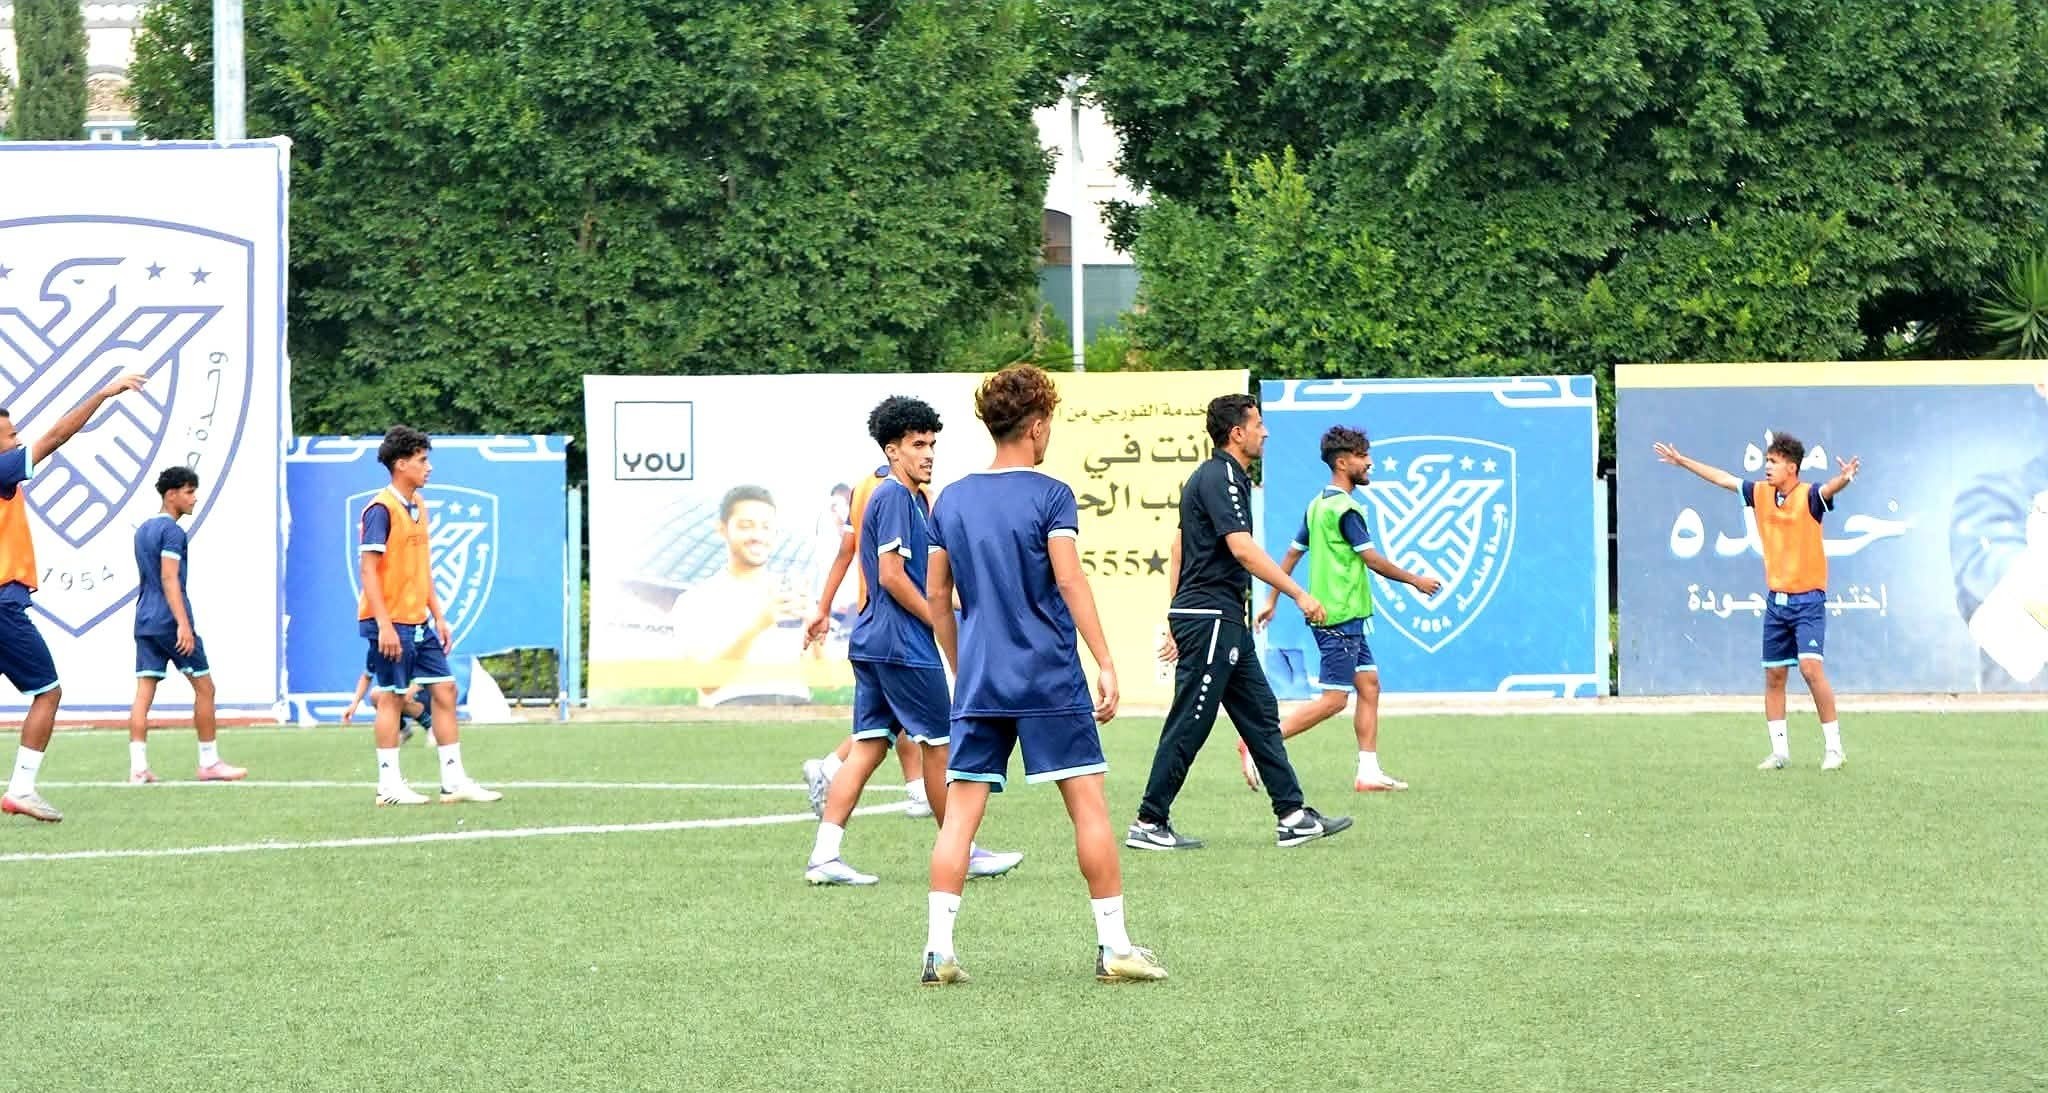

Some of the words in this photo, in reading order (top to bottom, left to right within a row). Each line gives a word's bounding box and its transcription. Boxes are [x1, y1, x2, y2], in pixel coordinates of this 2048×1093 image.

[623, 452, 686, 472] YOU
[1084, 433, 1141, 480] في
[1140, 481, 1183, 522] لب
[43, 565, 114, 591] 1954
[1412, 615, 1452, 633] 1954
